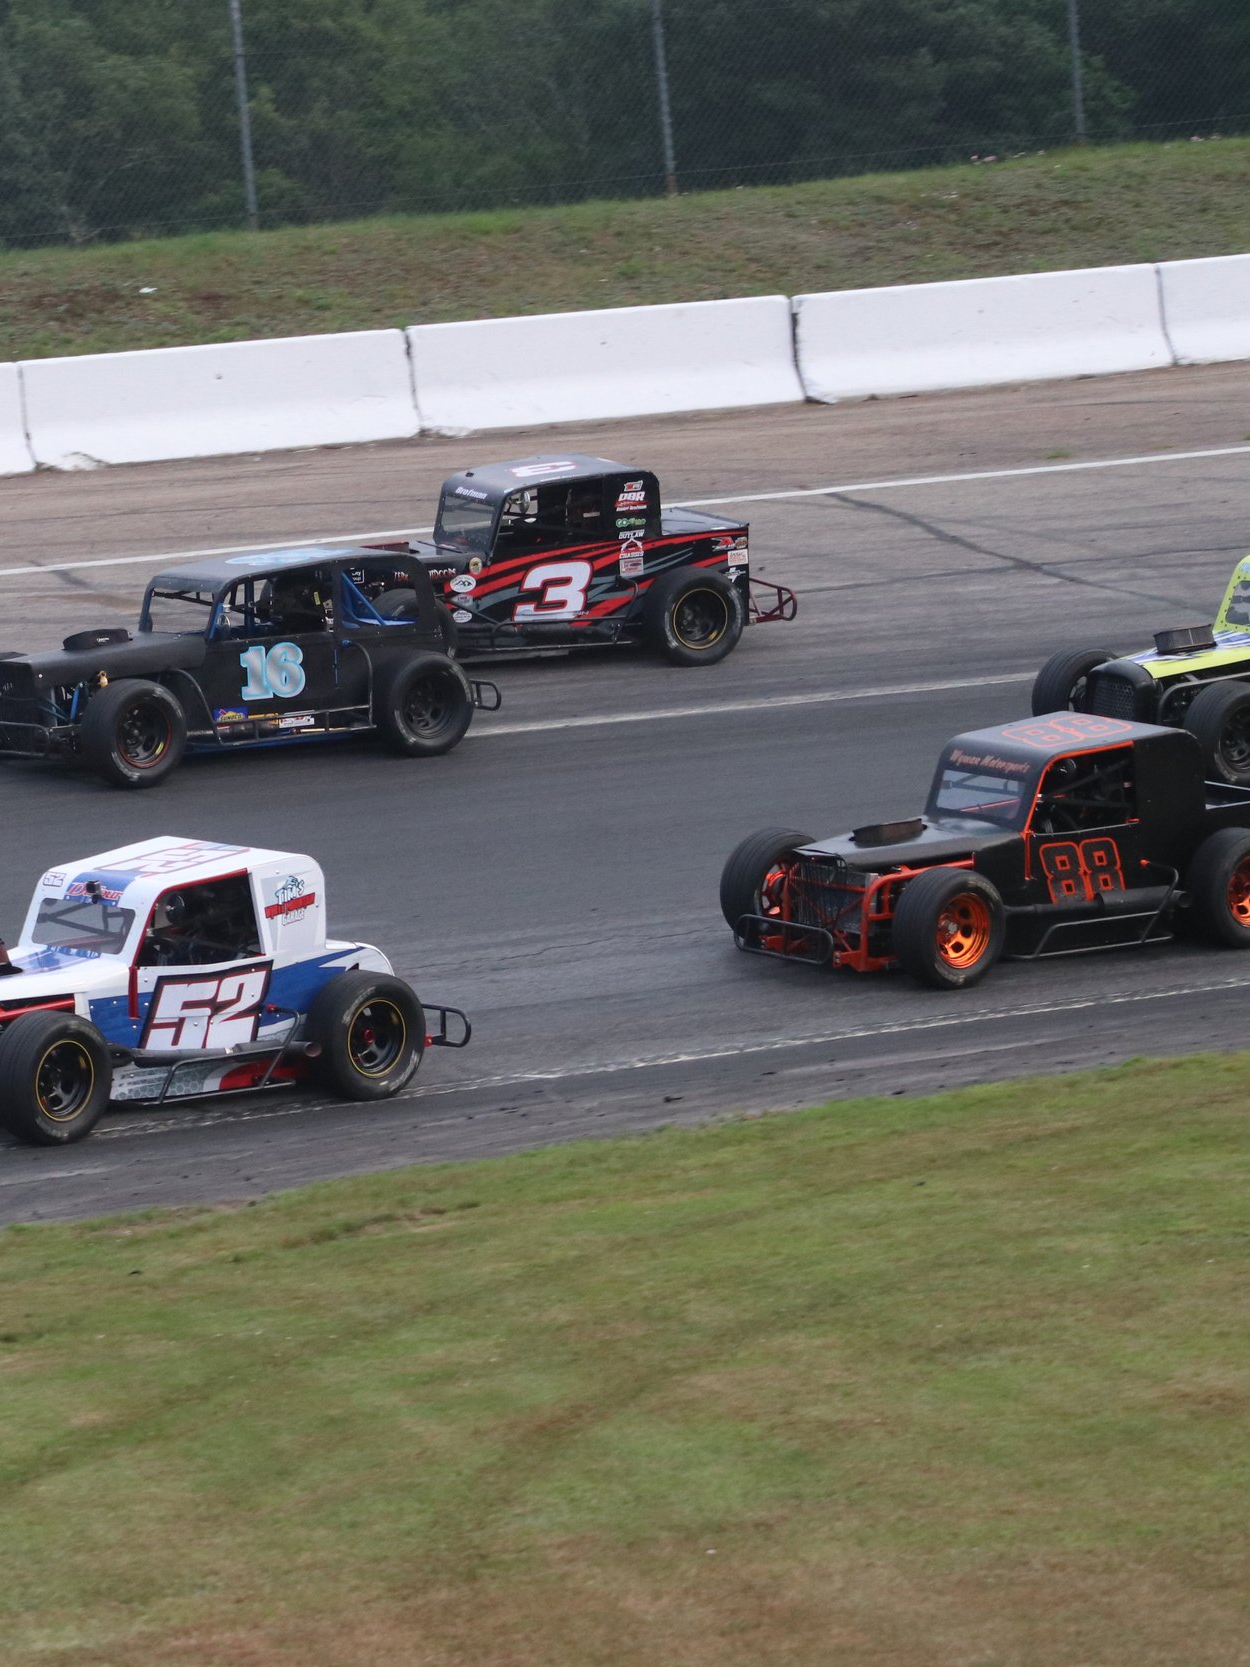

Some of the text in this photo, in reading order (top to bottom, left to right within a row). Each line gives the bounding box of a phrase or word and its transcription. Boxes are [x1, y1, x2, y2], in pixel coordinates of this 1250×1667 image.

[618, 491, 645, 502] DBR
[512, 558, 594, 623] 3
[240, 642, 306, 701] 16
[43, 871, 66, 887] 52
[1039, 837, 1127, 905] 88
[144, 968, 269, 1050] 52
